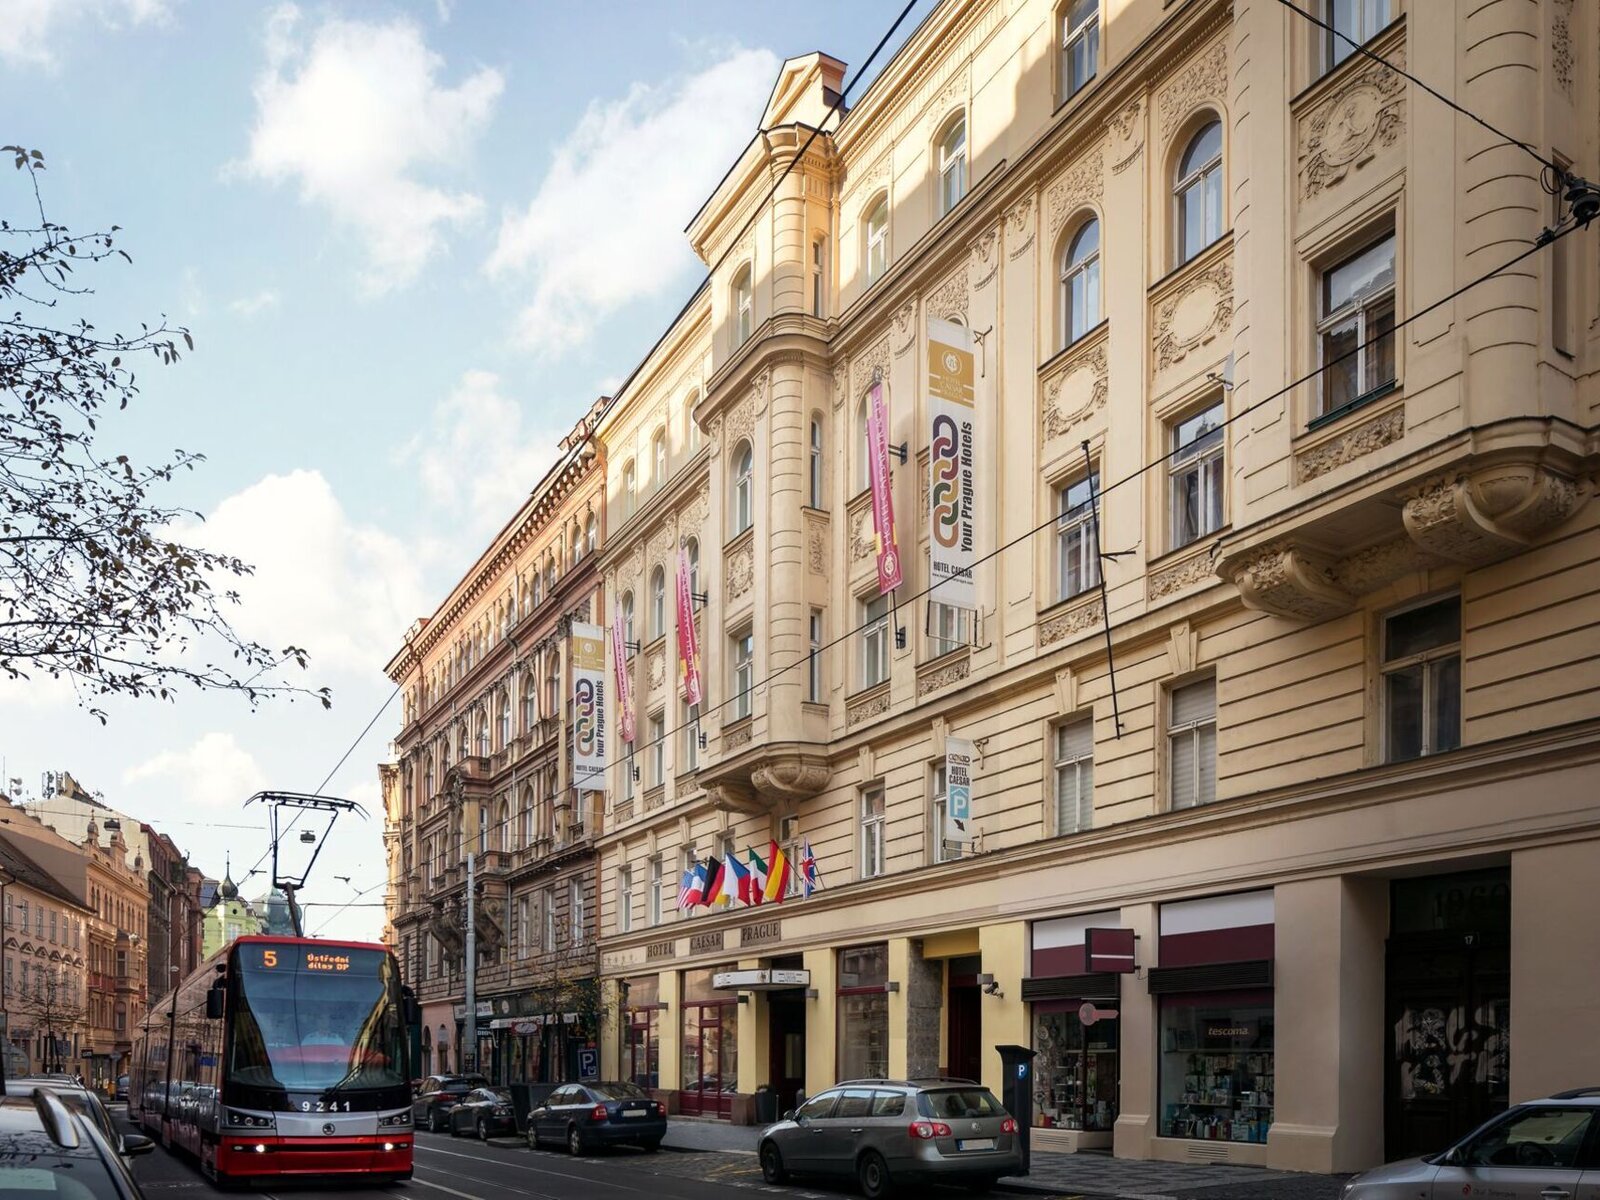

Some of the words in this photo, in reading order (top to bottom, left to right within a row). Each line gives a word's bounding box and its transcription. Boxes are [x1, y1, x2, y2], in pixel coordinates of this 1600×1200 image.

[961, 421, 972, 465] Hotels
[961, 468, 974, 519] Prague
[961, 522, 972, 552] Your
[933, 561, 950, 573] HOTEL
[595, 680, 604, 707] Hotels
[596, 707, 605, 739] Prague
[595, 740, 604, 758] Your
[949, 775, 970, 786] CAESAR
[951, 766, 967, 778] HOTEL
[954, 795, 967, 815] P
[647, 942, 673, 958] HOTEL
[690, 933, 722, 950] CAESAR
[742, 923, 779, 942] PRAGUE
[1464, 935, 1473, 945] 17
[264, 950, 277, 967] 5
[582, 1053, 594, 1070] P
[1018, 1064, 1025, 1077] P
[302, 1101, 350, 1112] 9241
